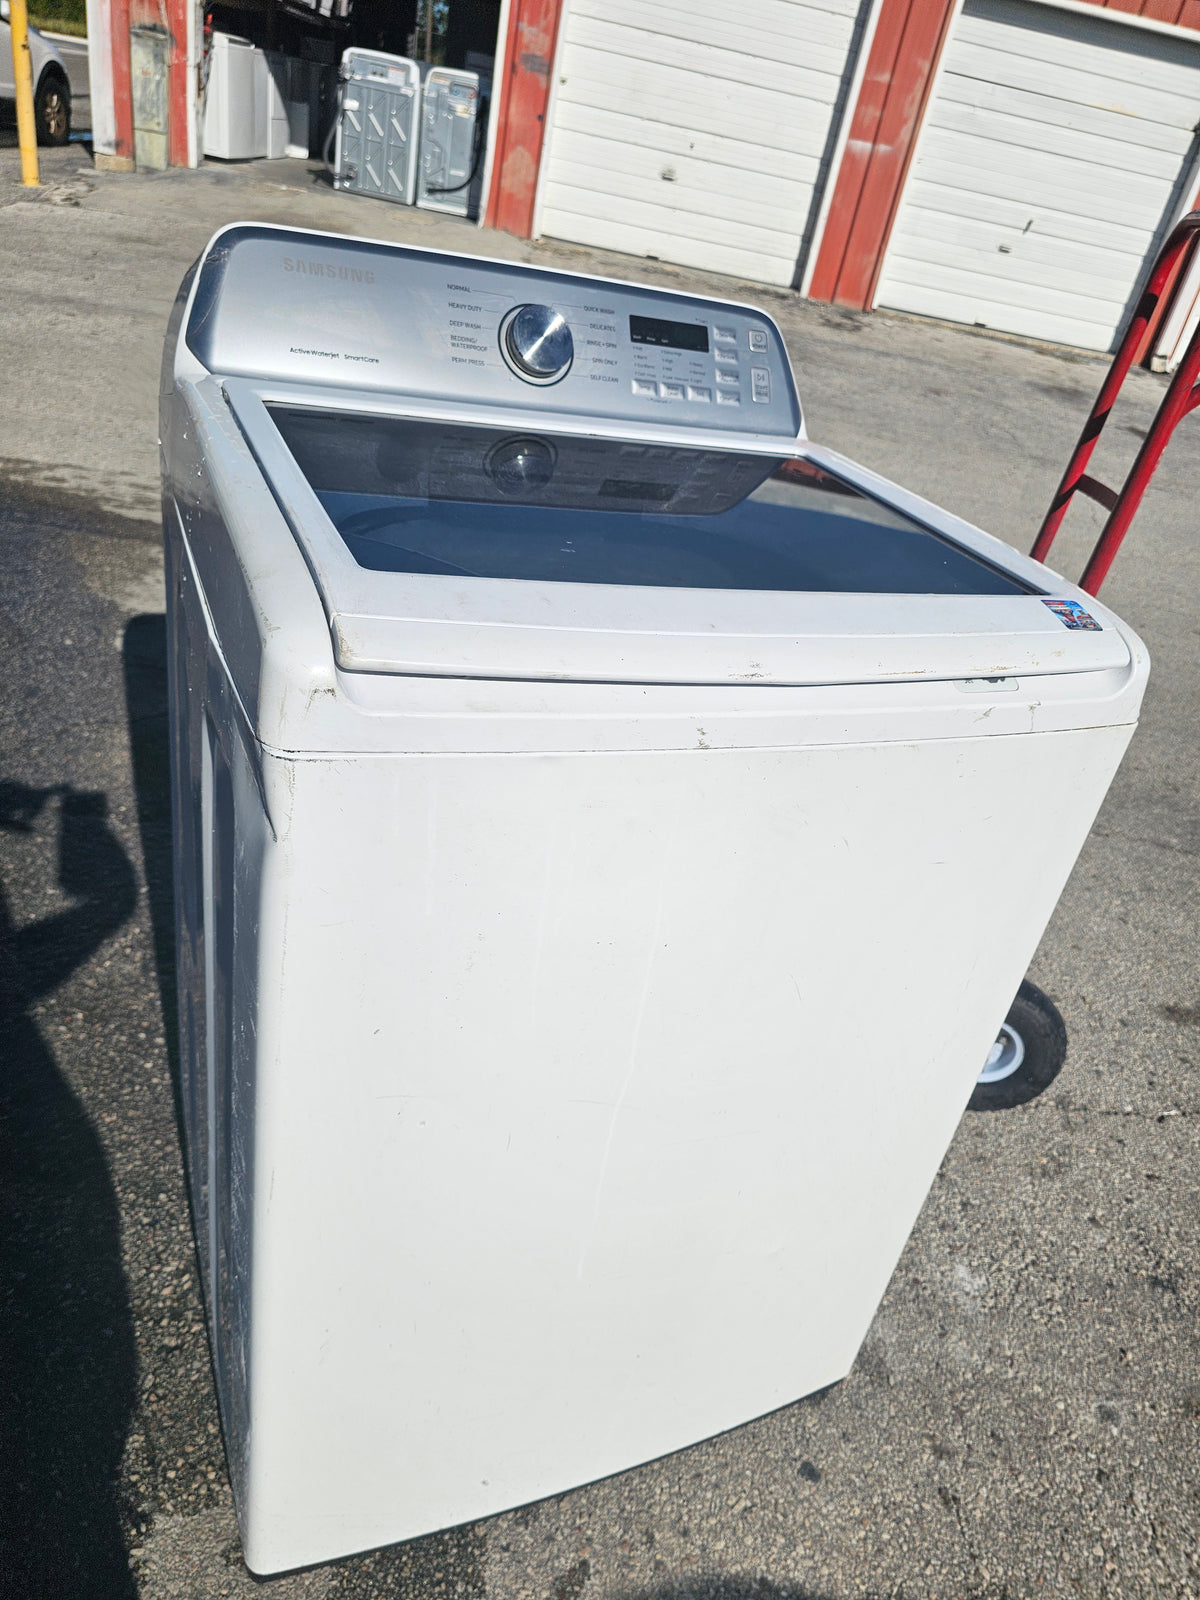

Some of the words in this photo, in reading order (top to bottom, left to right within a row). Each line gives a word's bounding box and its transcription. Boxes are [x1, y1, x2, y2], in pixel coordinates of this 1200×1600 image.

[283, 257, 376, 285] SAMSUNG
[446, 284, 471, 293] NORMAL
[448, 302, 467, 310] HEAVY
[467, 304, 482, 312] DUTY
[584, 305, 599, 313] QUICK
[449, 319, 463, 328] DEEP
[464, 322, 481, 330] WASH
[344, 354, 380, 363] SmartCare
[602, 376, 619, 384] CLEAN
